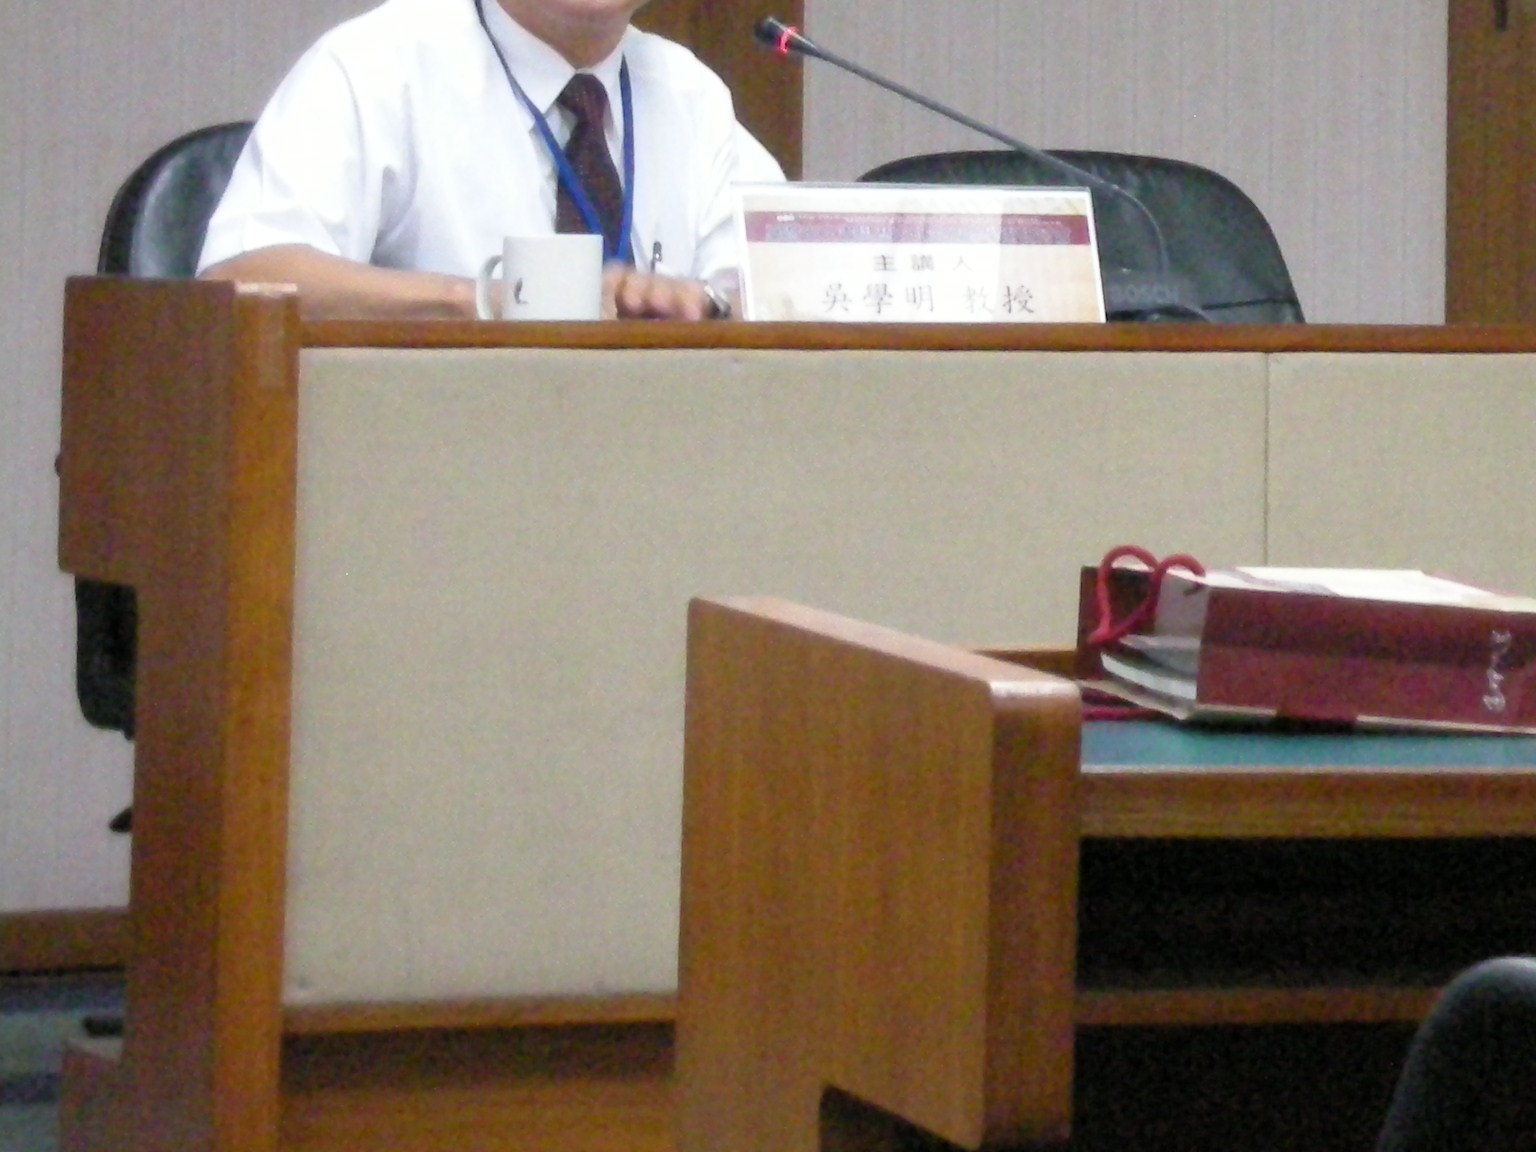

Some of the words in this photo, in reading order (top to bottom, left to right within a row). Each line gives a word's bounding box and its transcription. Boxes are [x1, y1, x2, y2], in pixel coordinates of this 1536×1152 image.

[821, 283, 936, 315] 吳學明
[963, 284, 1036, 315] 教授
